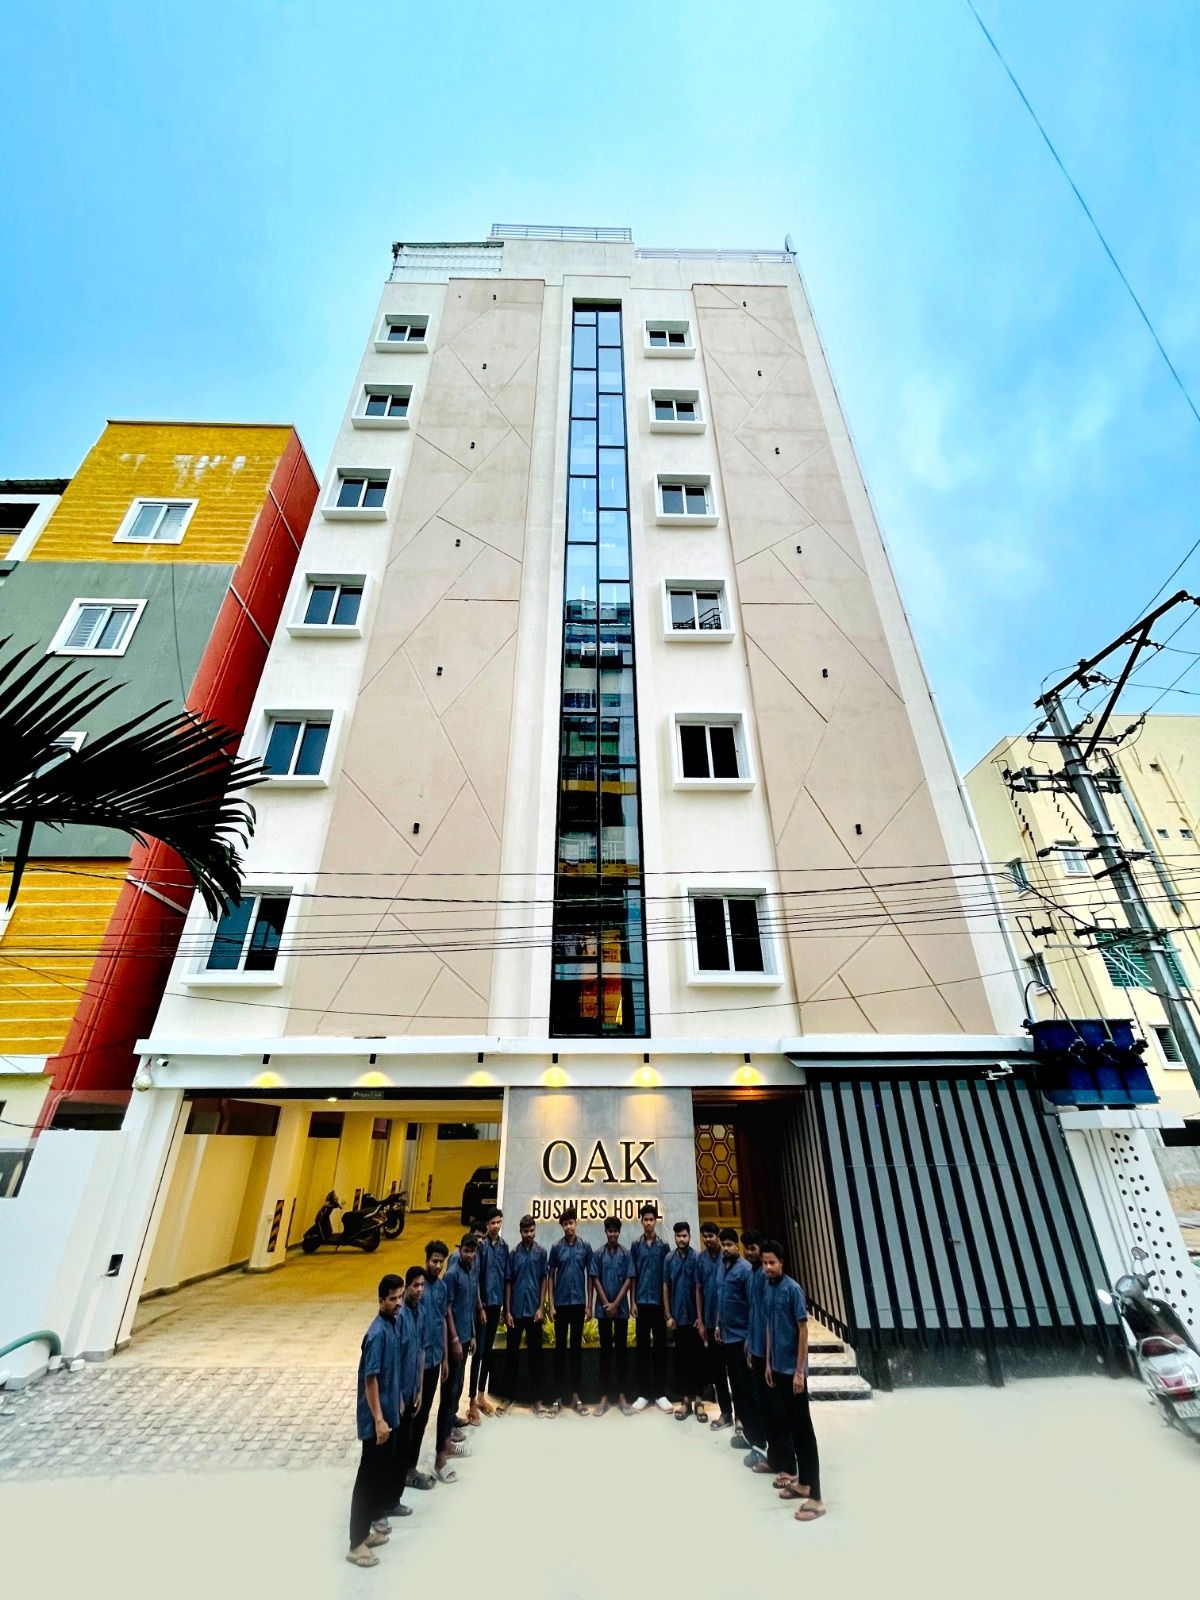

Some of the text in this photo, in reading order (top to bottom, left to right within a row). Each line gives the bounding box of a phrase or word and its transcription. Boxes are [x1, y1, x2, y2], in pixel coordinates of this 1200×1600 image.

[542, 1140, 657, 1184] OAK
[532, 1199, 663, 1219] BUSINESS HOTL
